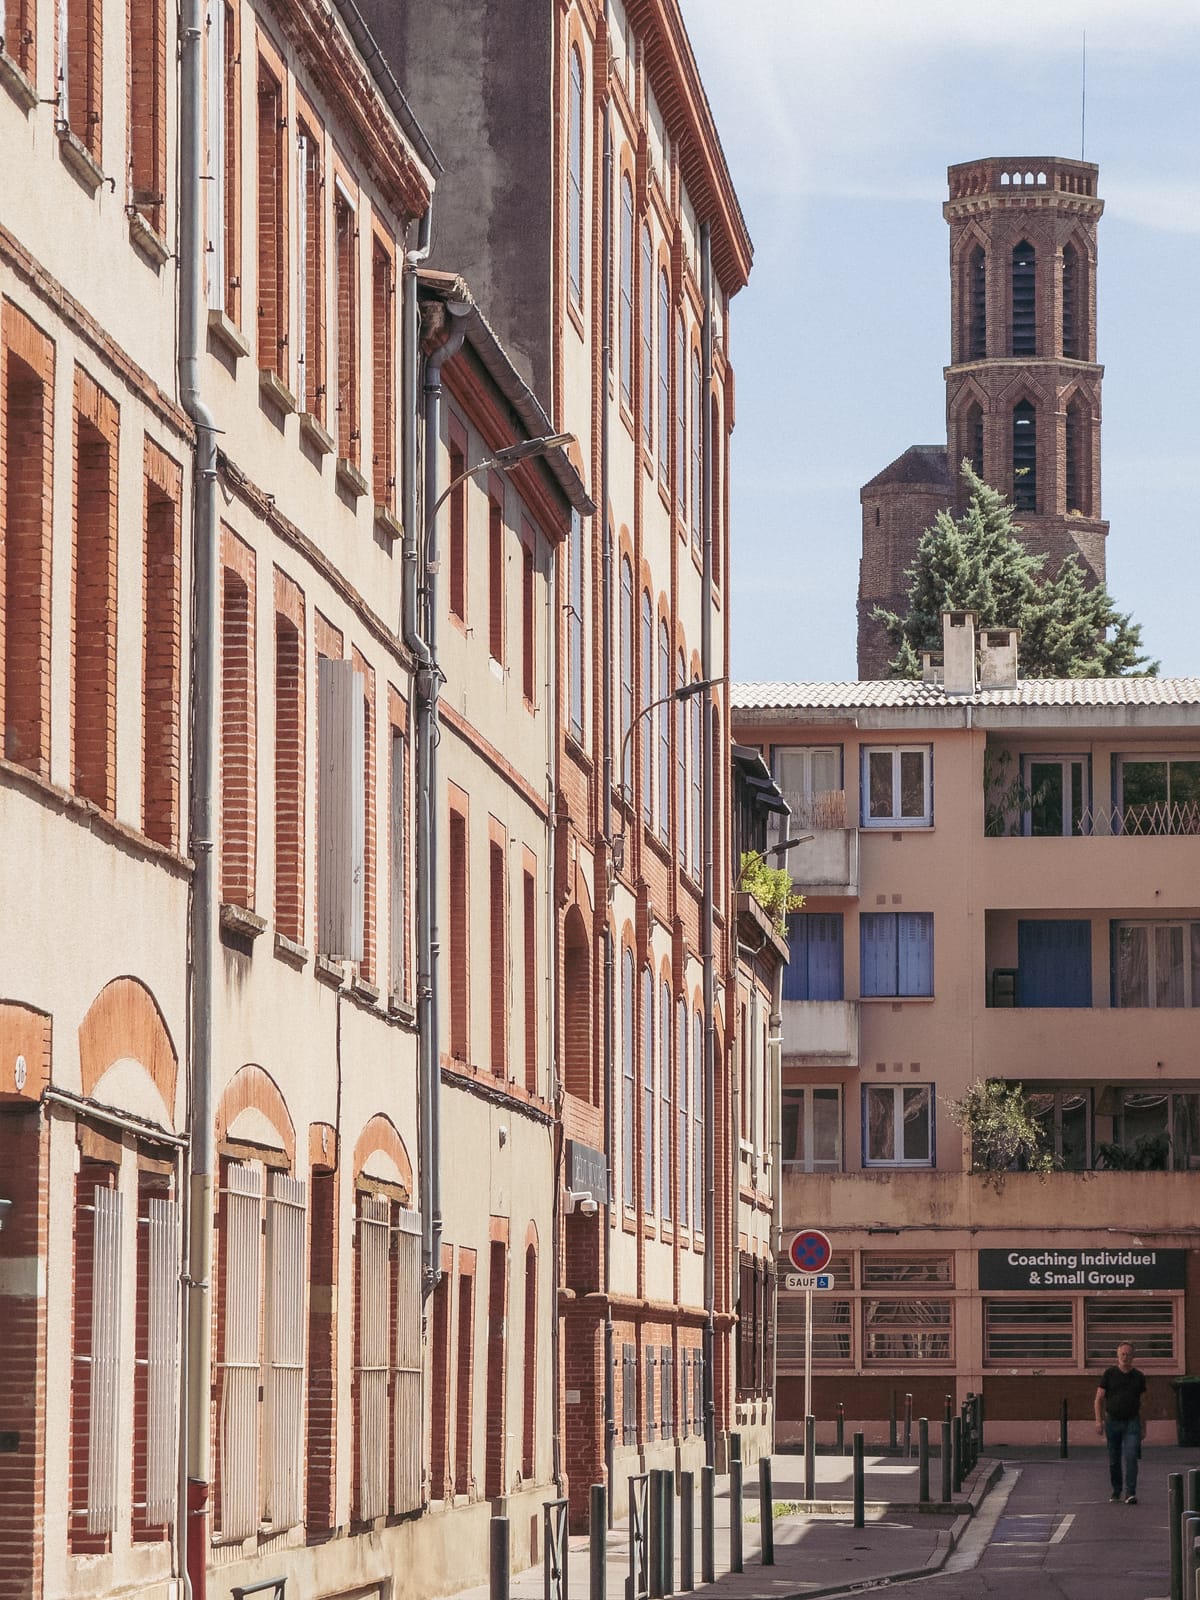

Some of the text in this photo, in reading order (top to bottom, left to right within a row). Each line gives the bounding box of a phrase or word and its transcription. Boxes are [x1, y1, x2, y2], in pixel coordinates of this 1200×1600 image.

[1008, 1252, 1157, 1269] Coaching Individuel
[789, 1278, 816, 1287] SAUF
[1029, 1271, 1136, 1288] & Small Group
